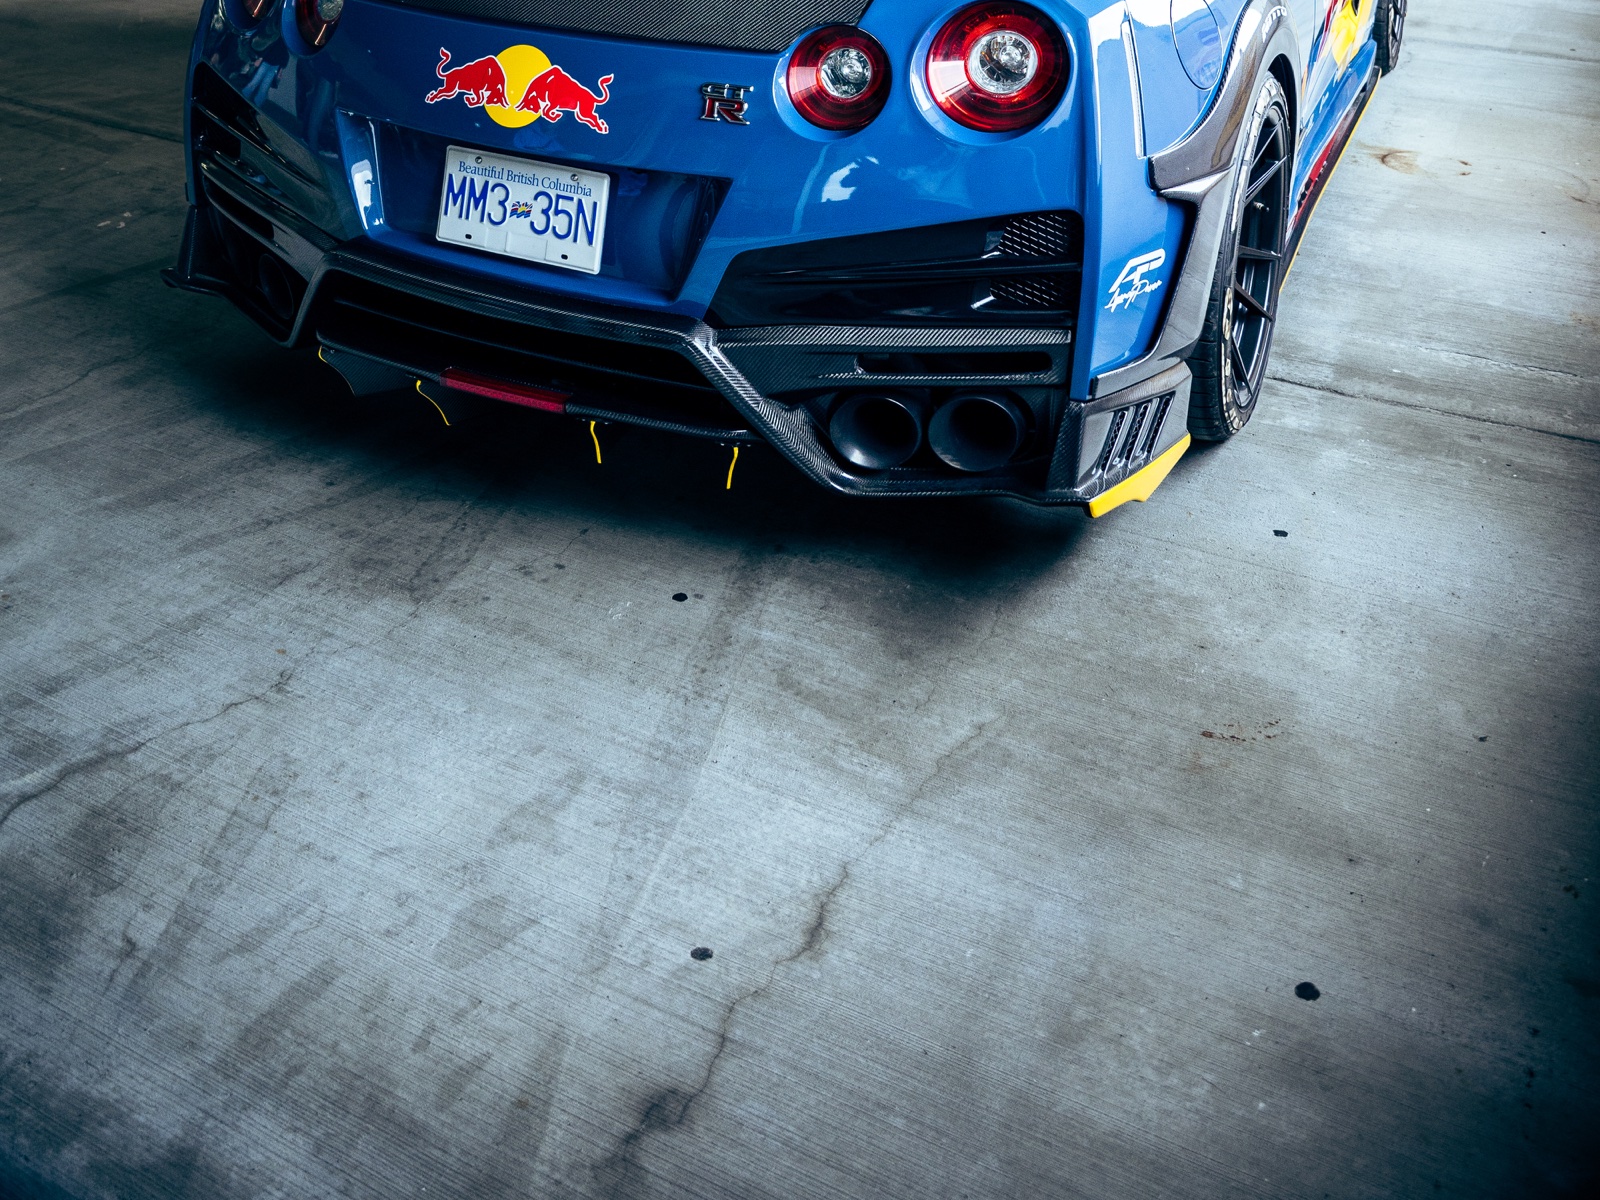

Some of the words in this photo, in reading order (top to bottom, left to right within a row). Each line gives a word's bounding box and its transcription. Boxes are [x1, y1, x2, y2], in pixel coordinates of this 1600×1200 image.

[458, 160, 505, 180] Beautiful
[506, 169, 539, 187] British
[541, 176, 592, 198] Columbia
[444, 173, 510, 227] MM3
[529, 190, 599, 247] 35N
